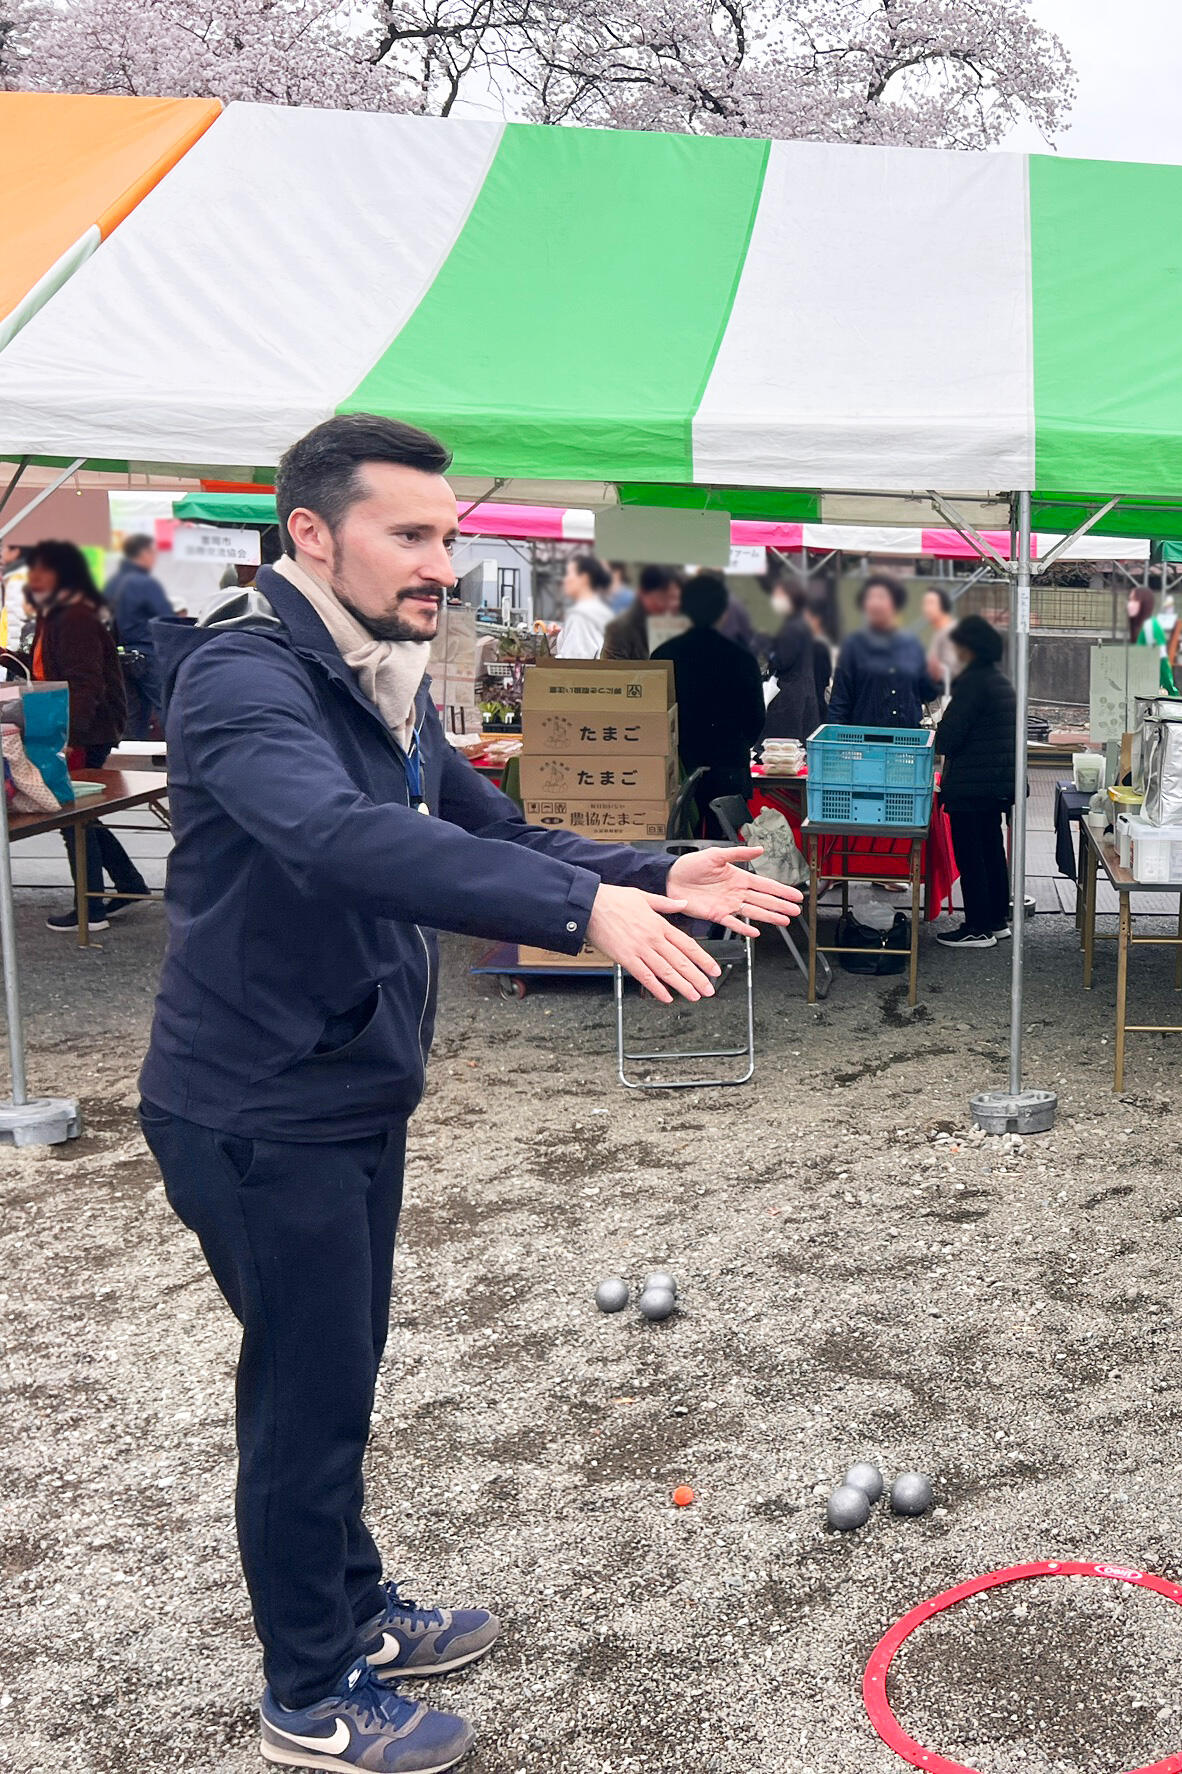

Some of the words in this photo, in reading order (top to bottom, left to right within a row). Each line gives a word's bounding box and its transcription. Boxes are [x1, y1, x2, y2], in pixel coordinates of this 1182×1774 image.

[579, 725, 641, 742] たまご
[576, 769, 638, 786] たまご
[570, 811, 646, 826] 農協たまご
